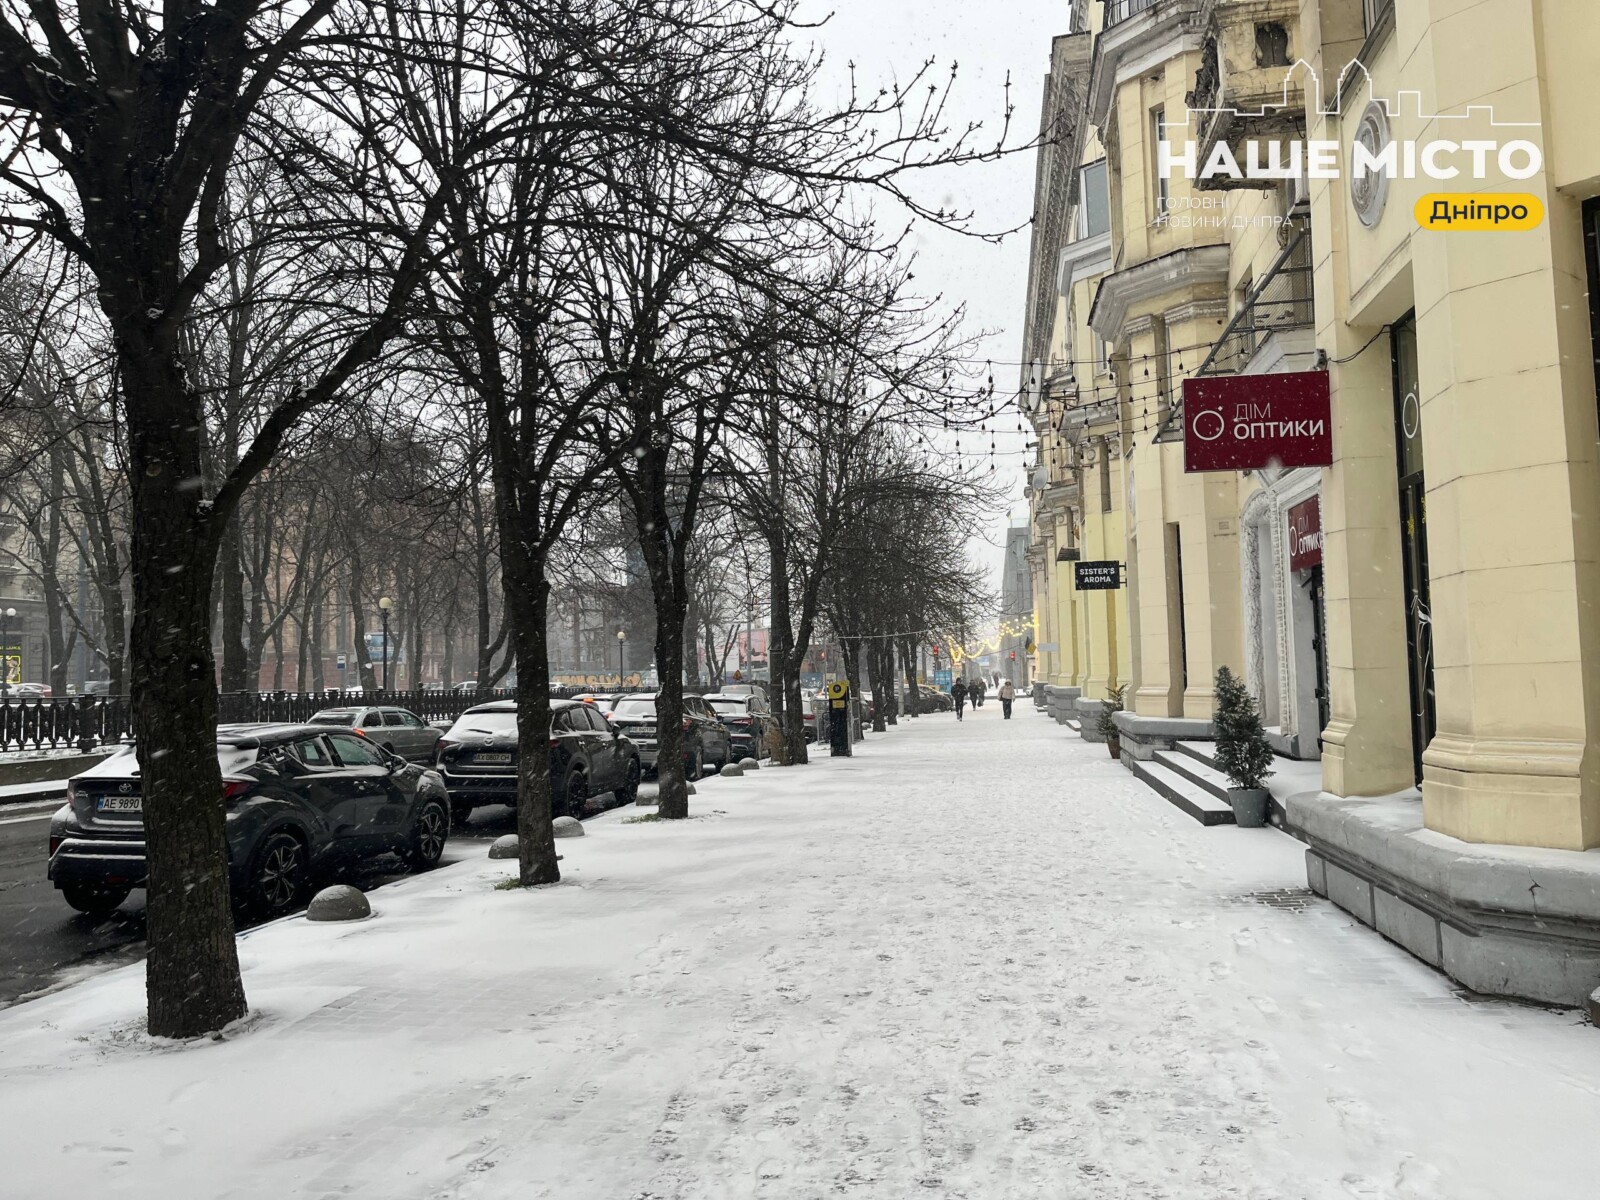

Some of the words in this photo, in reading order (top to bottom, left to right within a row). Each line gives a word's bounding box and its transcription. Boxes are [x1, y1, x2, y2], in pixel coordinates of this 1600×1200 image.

[1234, 402, 1272, 422] ДІМ
[1233, 419, 1325, 440] ОПТИКИ
[1079, 567, 1116, 576] SISTER'S
[103, 798, 118, 809] AE
[118, 798, 140, 809] 9890
